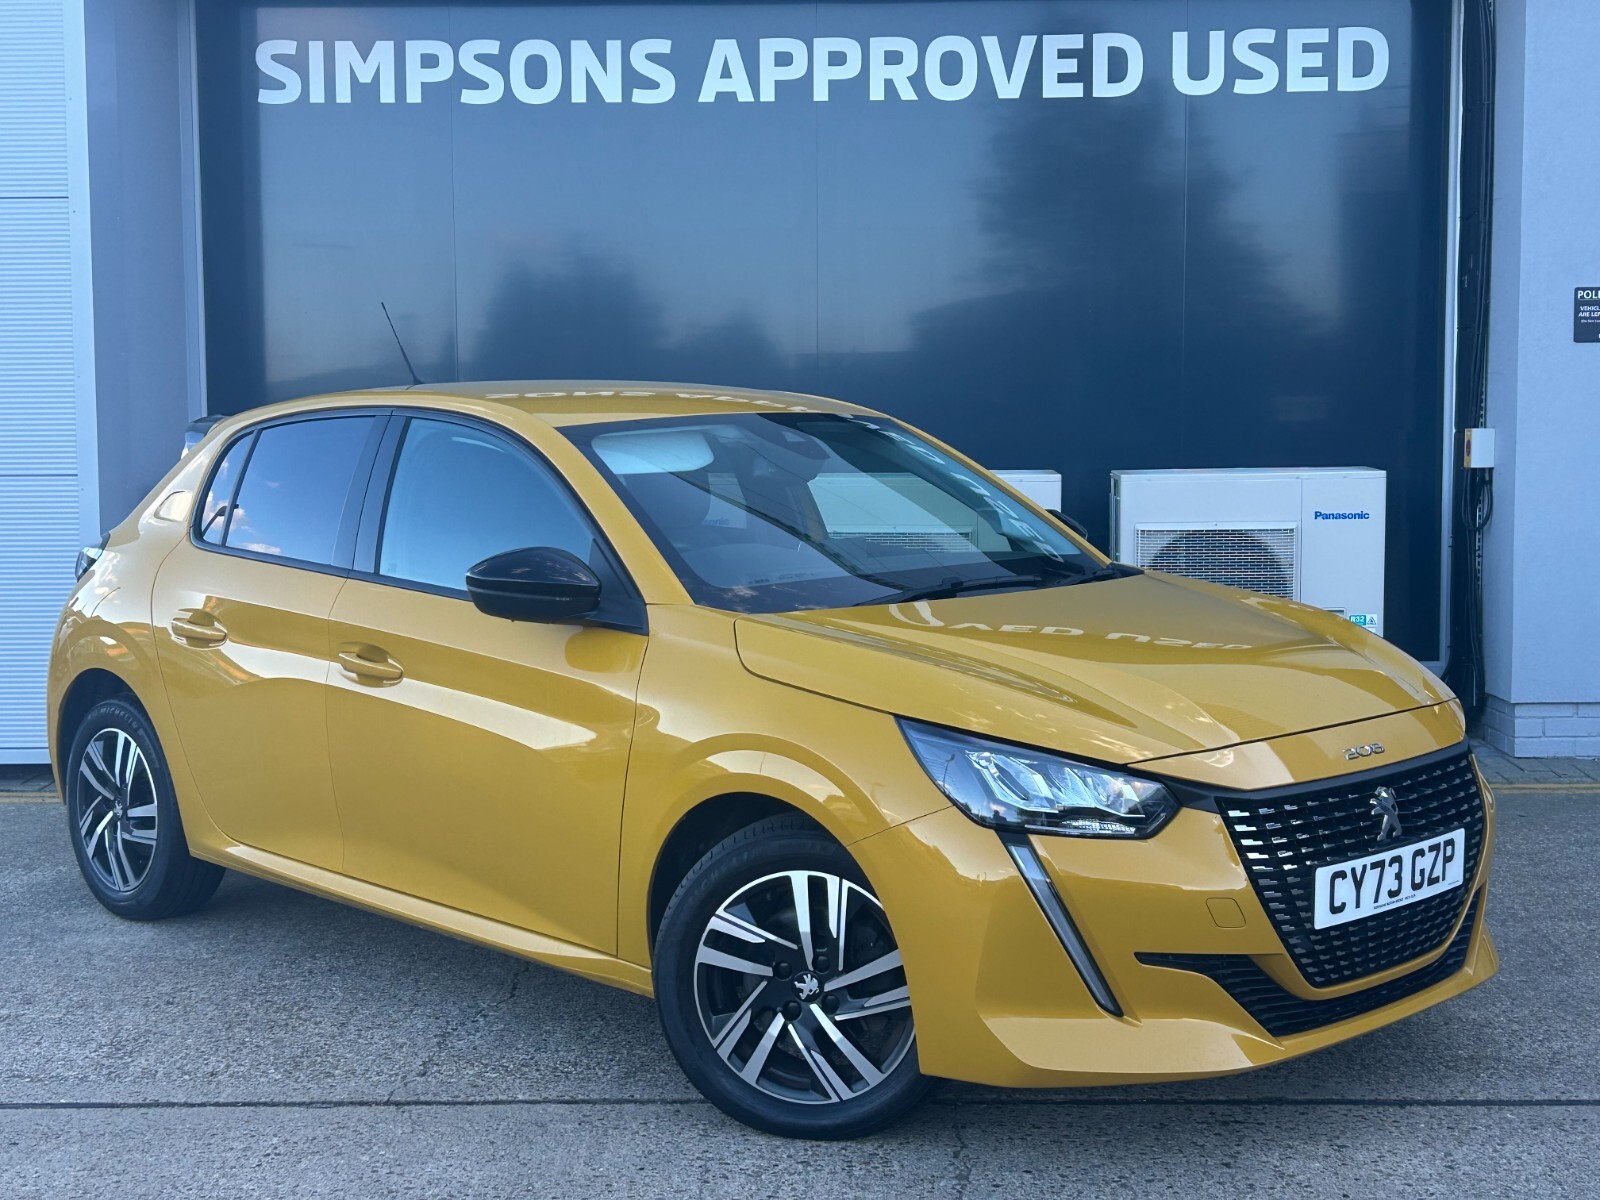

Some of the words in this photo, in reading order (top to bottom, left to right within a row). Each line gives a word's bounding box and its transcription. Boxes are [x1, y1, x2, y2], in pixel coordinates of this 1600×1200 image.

[256, 38, 677, 106] SIMPSONS
[698, 33, 1144, 104] APPROVED
[1172, 26, 1390, 97] USED
[1314, 510, 1370, 521] Panasonic
[1342, 742, 1386, 761] 208
[1328, 860, 1403, 915] CY73
[1410, 837, 1456, 892] GZP
